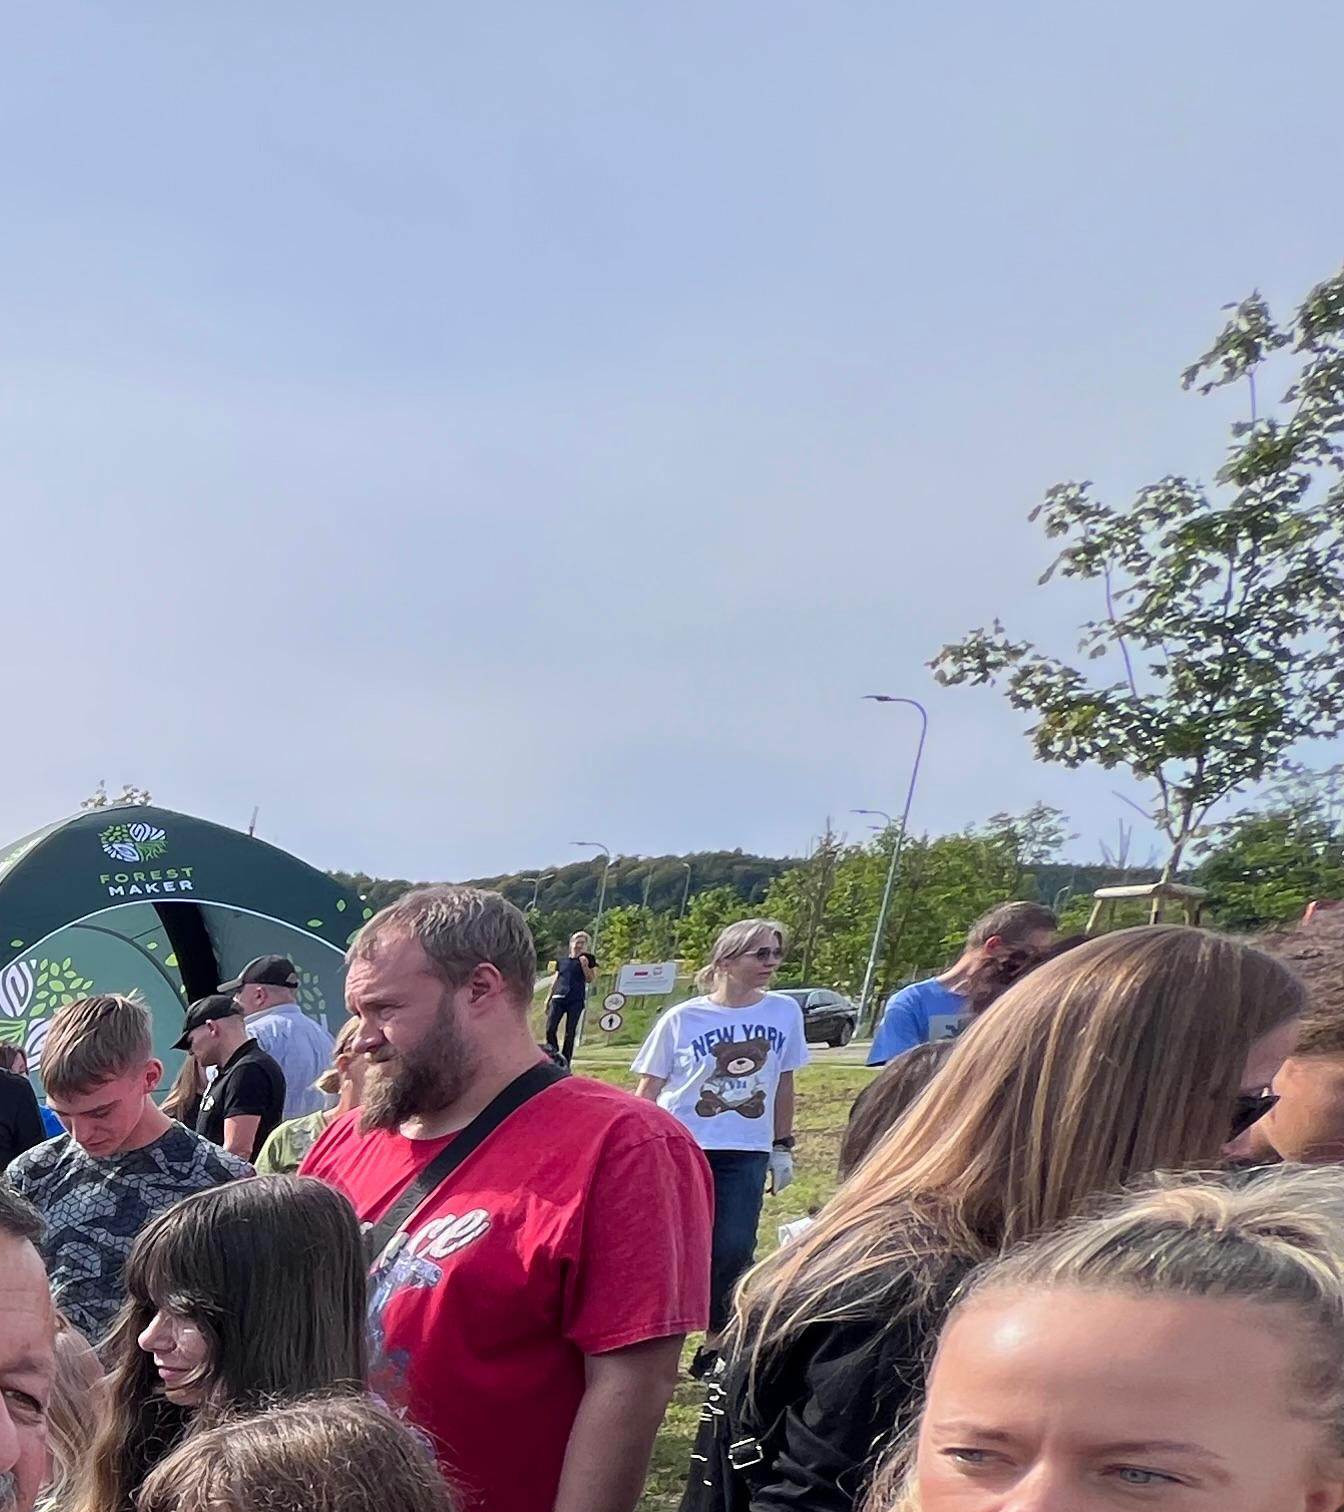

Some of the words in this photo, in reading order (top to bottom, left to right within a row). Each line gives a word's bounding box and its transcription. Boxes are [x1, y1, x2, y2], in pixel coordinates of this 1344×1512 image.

[99, 866, 193, 884] FOREST
[108, 880, 194, 897] MAKER
[692, 1025, 735, 1062] NEW
